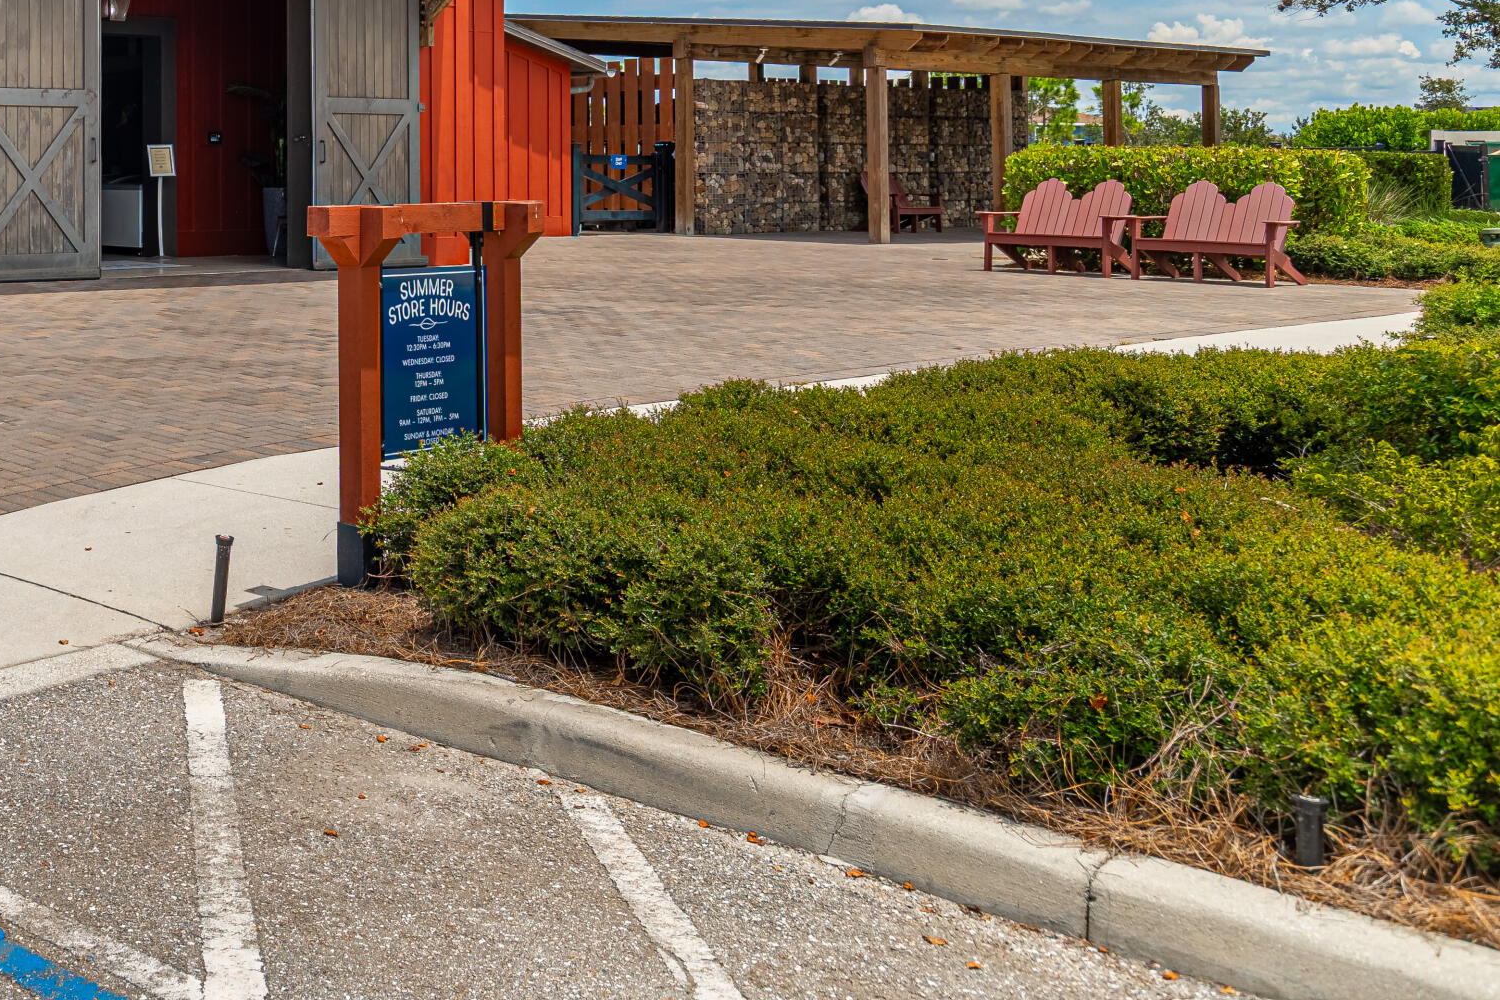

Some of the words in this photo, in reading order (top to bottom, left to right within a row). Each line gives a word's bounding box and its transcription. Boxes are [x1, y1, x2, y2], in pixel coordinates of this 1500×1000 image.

[400, 278, 454, 300] SUMMER
[388, 299, 426, 325] STORE
[430, 298, 471, 321] HOURS
[436, 355, 454, 363] CLOSED
[429, 392, 448, 400] CLOSED
[417, 407, 442, 416] SATURDAY:
[404, 432, 424, 440] SUNDAY
